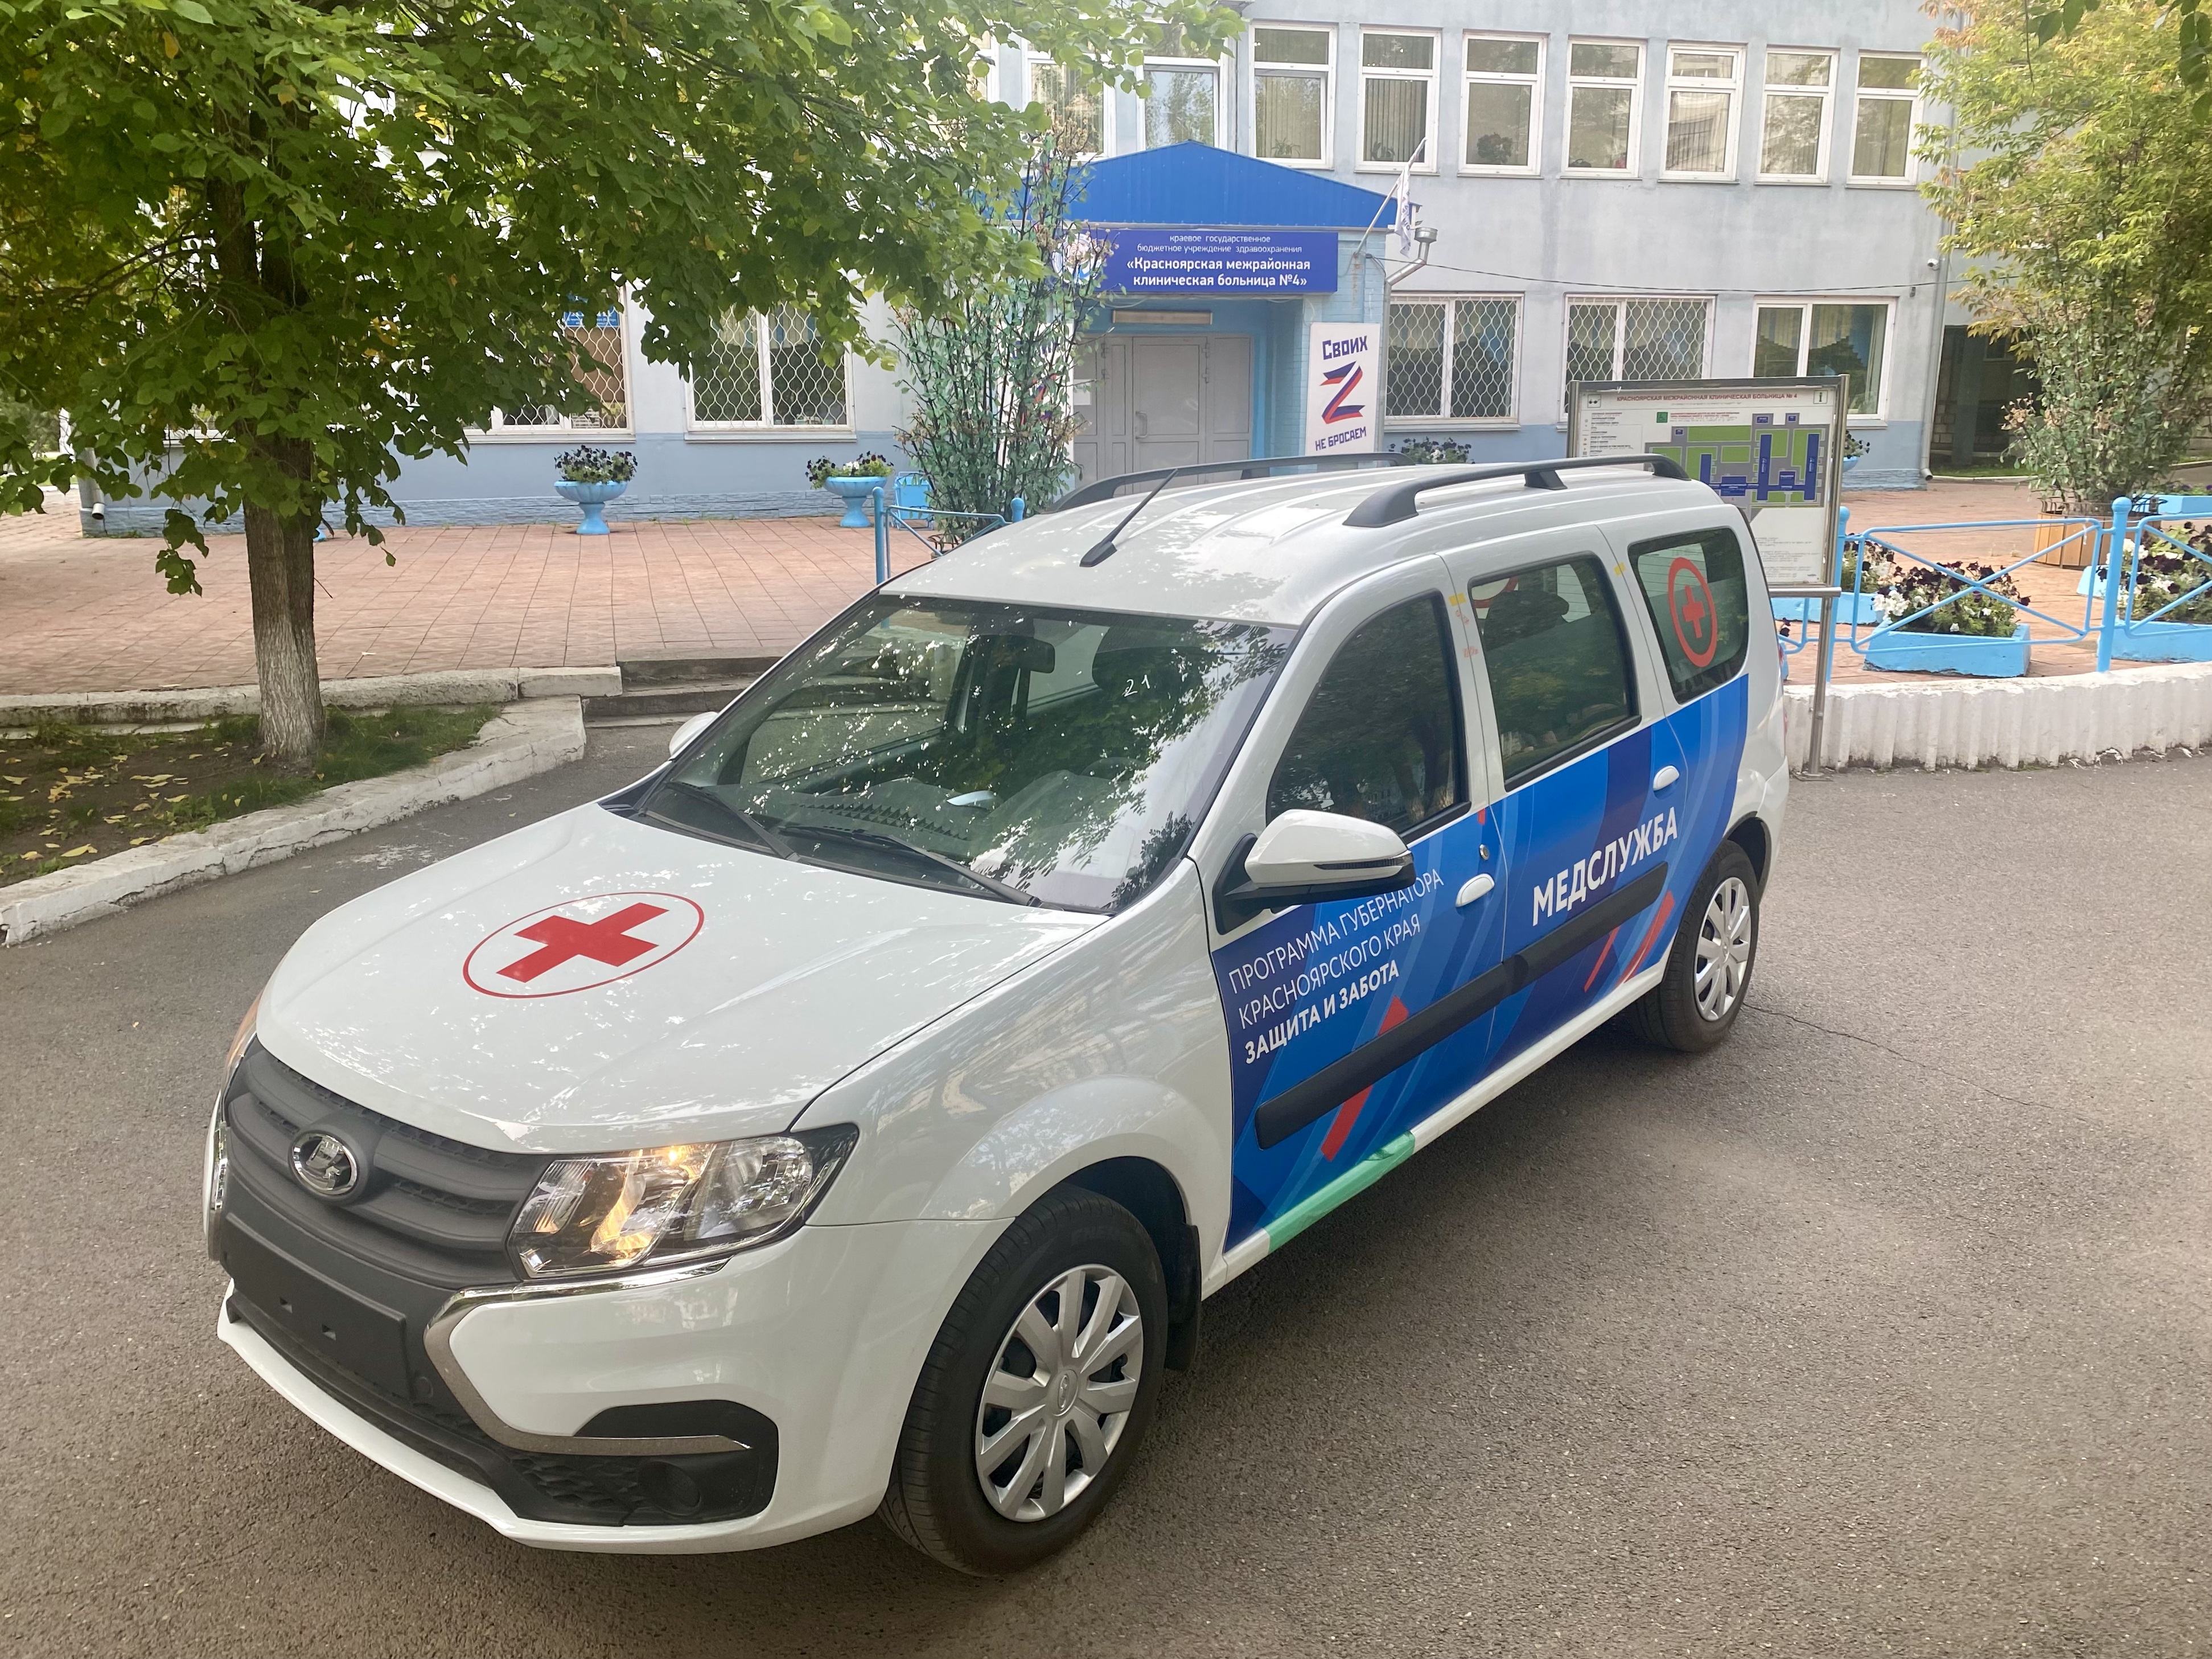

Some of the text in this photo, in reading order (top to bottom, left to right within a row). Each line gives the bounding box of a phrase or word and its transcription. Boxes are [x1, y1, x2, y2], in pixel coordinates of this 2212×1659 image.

[1126, 257, 1310, 272] «Красноярская межрайонная
[1137, 244, 1182, 253] бюджетное
[1235, 245, 1302, 253] здравоохранения
[1133, 273, 1308, 288] клиническая больница №4»
[1315, 426, 1367, 451] НЕ БРОСАЕМ
[1532, 806, 1678, 927] МЕДСЛУЖБА
[1228, 921, 1341, 994] ПРОГРАММА
[1239, 913, 1420, 1029] КРАСНОЯРСКОГО КРАЯ
[1244, 959, 1400, 1064] ЗАЩИТА И ЗАБОТА
